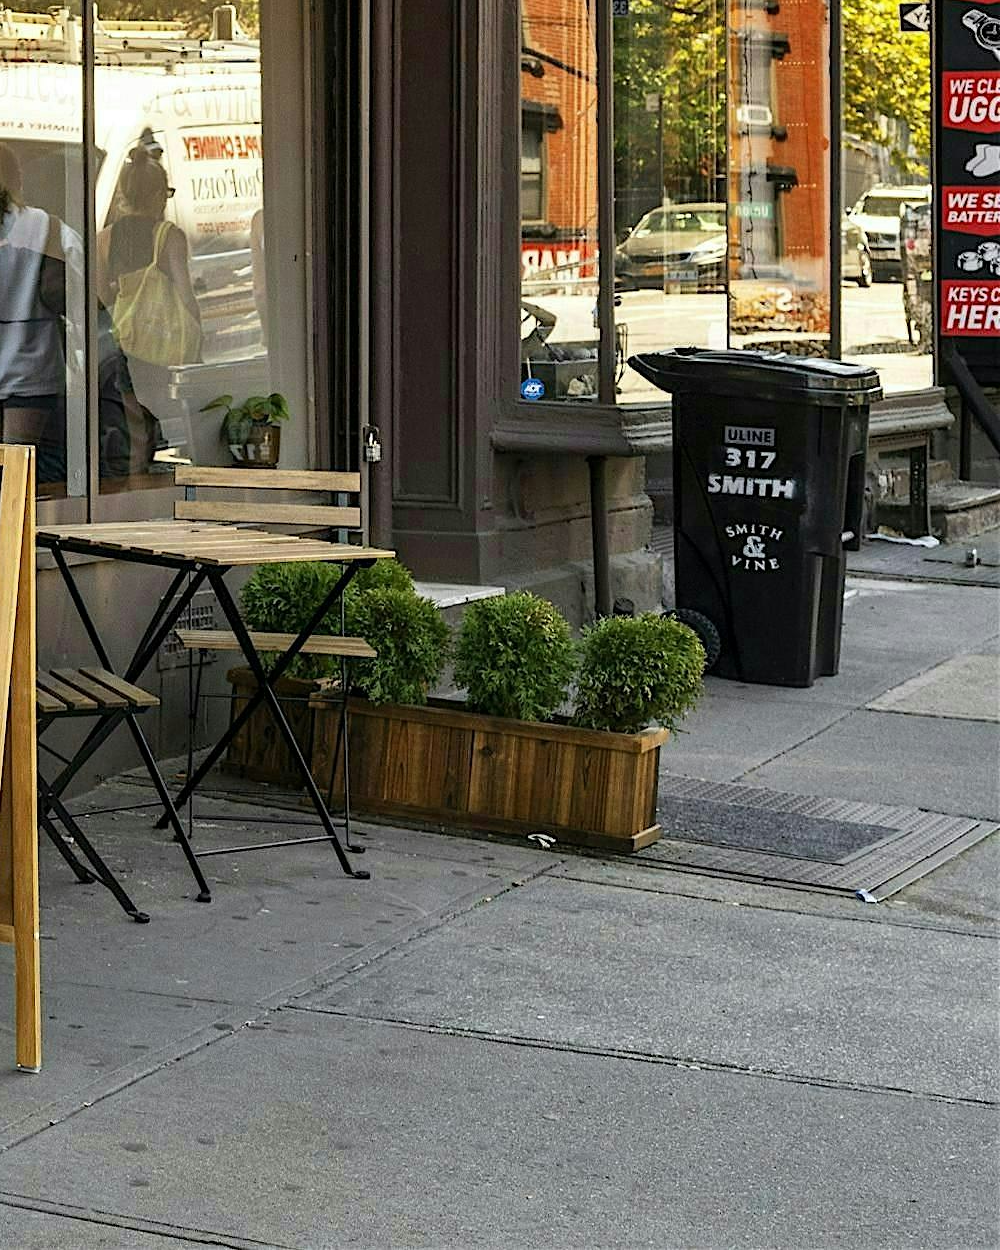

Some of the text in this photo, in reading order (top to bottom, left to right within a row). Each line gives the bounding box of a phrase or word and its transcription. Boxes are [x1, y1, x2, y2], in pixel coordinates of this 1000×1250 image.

[950, 78, 976, 95] WE
[948, 192, 979, 209] WE
[947, 286, 989, 302] KEYS
[946, 304, 1000, 330] HER
[727, 428, 773, 444] ULINE
[725, 446, 777, 470] 317
[707, 473, 797, 499] SMITH
[725, 523, 784, 541] SMITH
[742, 535, 766, 559] &
[731, 554, 781, 572] VINE
